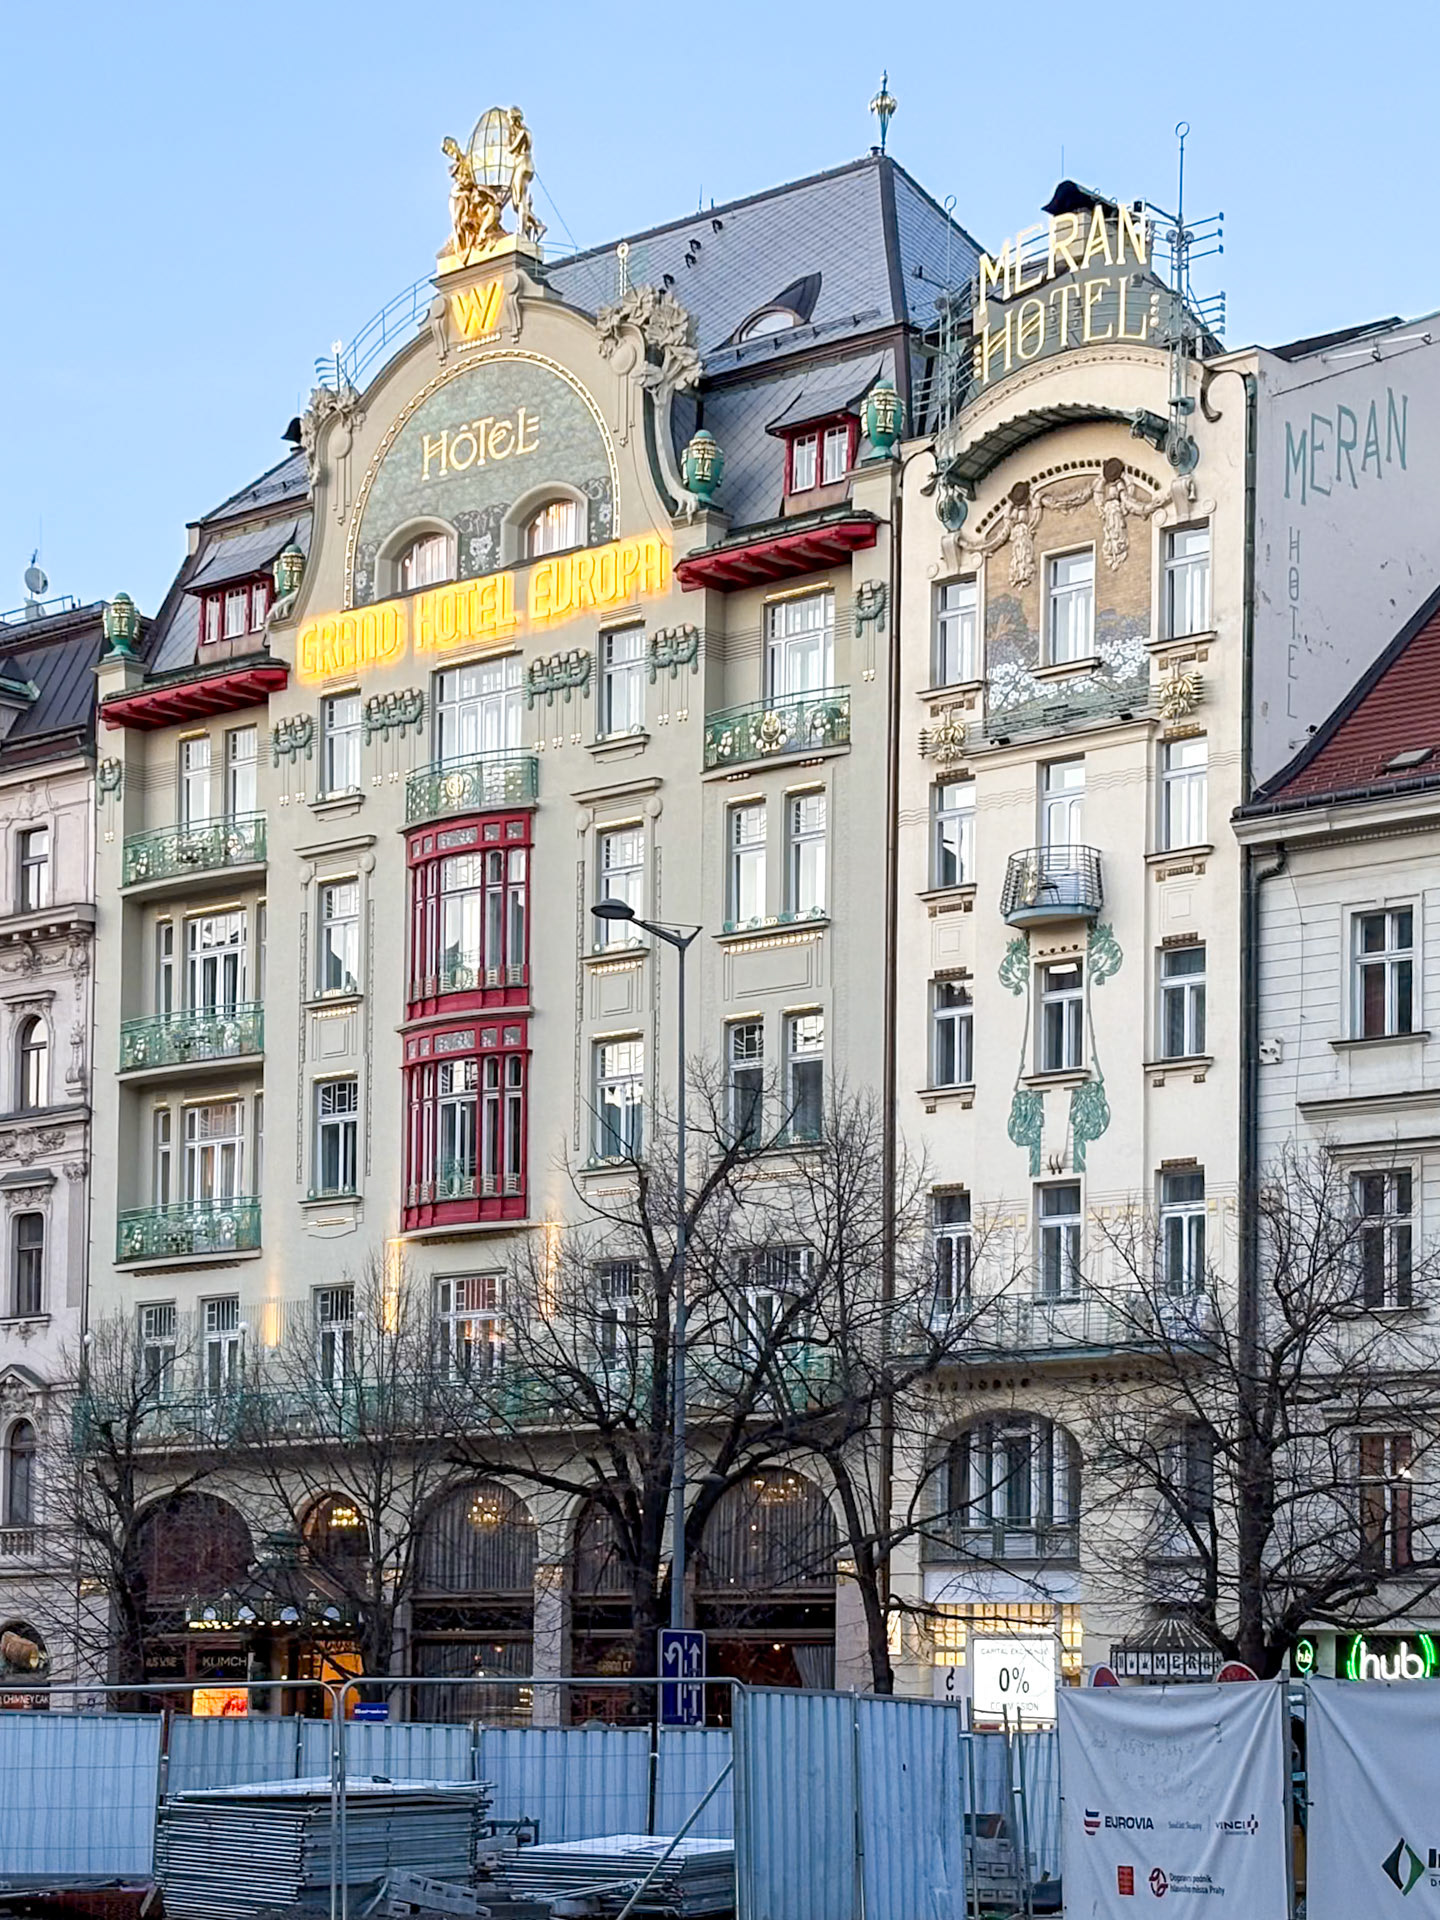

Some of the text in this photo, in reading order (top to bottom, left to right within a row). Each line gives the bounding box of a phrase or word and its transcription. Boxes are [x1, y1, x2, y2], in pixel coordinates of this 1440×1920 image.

[451, 281, 503, 337] W
[979, 204, 1147, 315] MERAN
[982, 277, 1147, 386] HOTEL
[1284, 387, 1408, 506] MERAN
[300, 537, 667, 676] GRAND HOTEL EUROPA
[1287, 526, 1301, 719] HOTEL
[999, 1666, 1030, 1694] 0%
[1105, 1816, 1154, 1830] EUROVIA
[1215, 1820, 1246, 1830] VINCI
